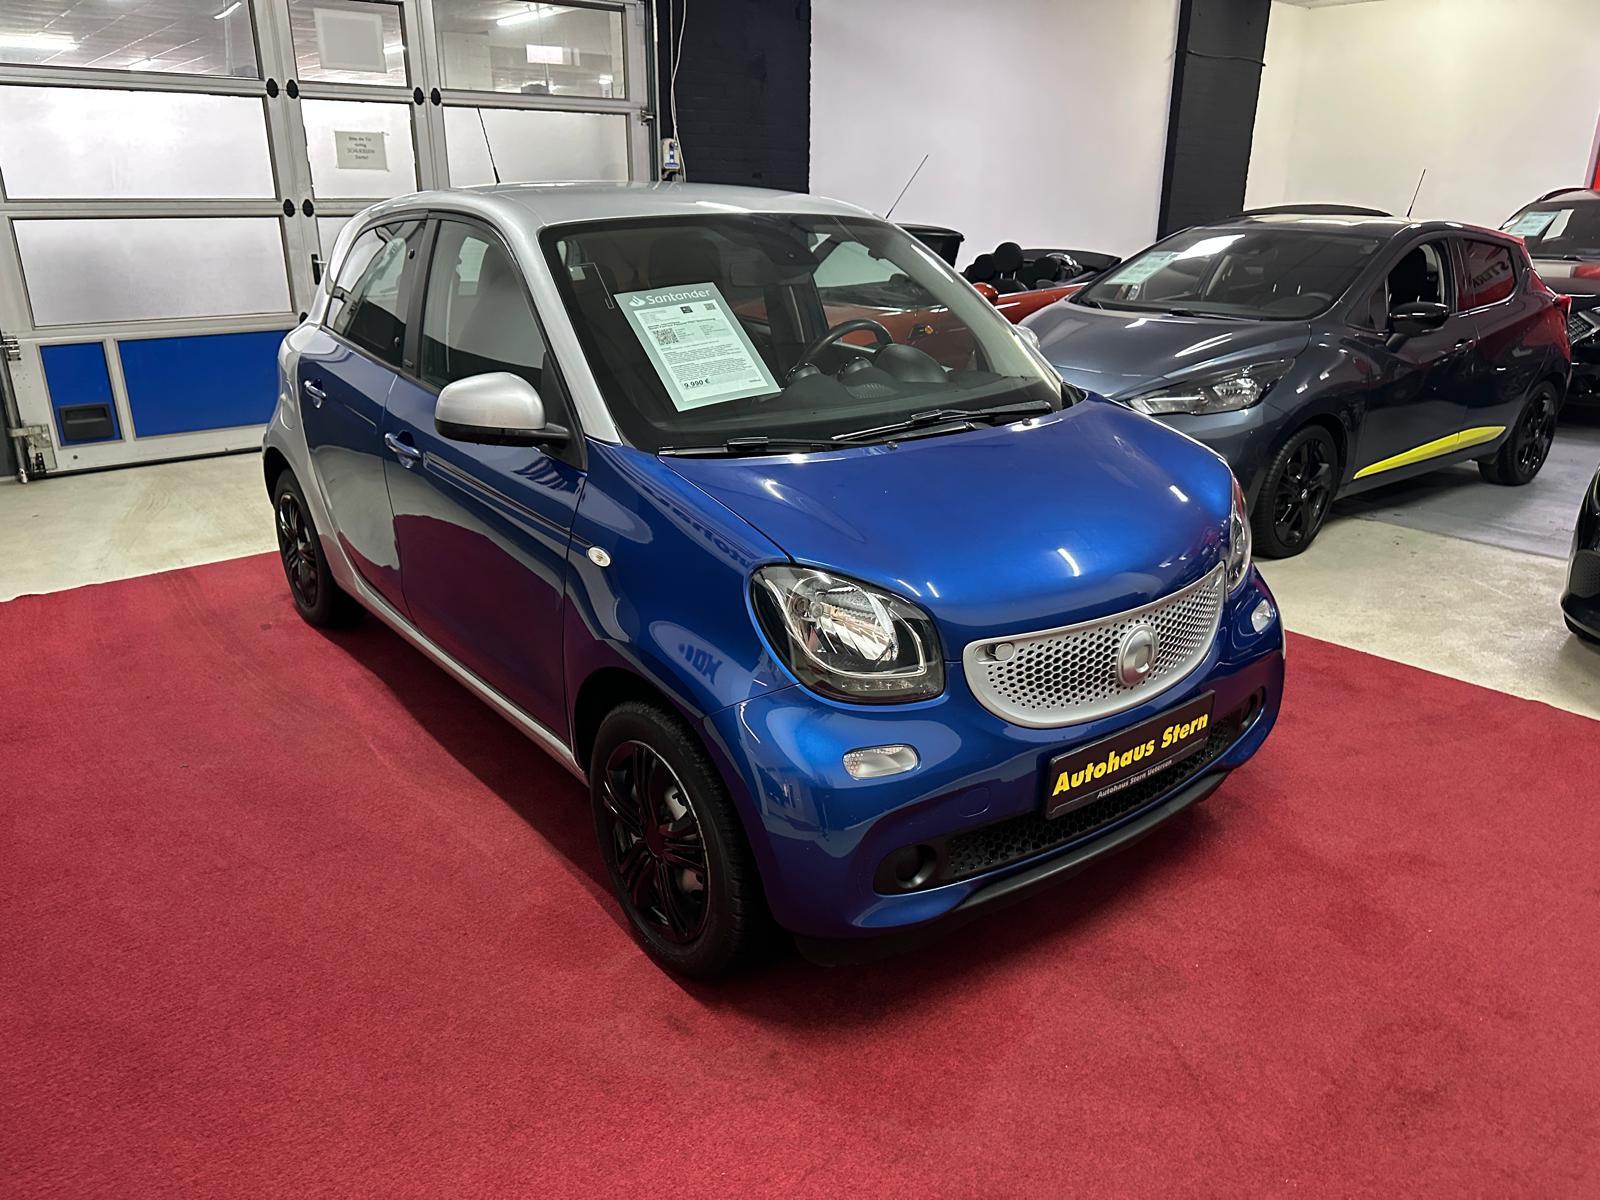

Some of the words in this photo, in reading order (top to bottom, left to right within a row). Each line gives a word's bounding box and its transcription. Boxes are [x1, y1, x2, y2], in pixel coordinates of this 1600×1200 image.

[646, 289, 710, 305] Santander
[683, 379, 704, 389] 9.990
[1052, 739, 1156, 796] Autohaus
[1161, 713, 1209, 749] Stern
[1096, 781, 1129, 799] Autohaus
[1129, 772, 1147, 785] Stern
